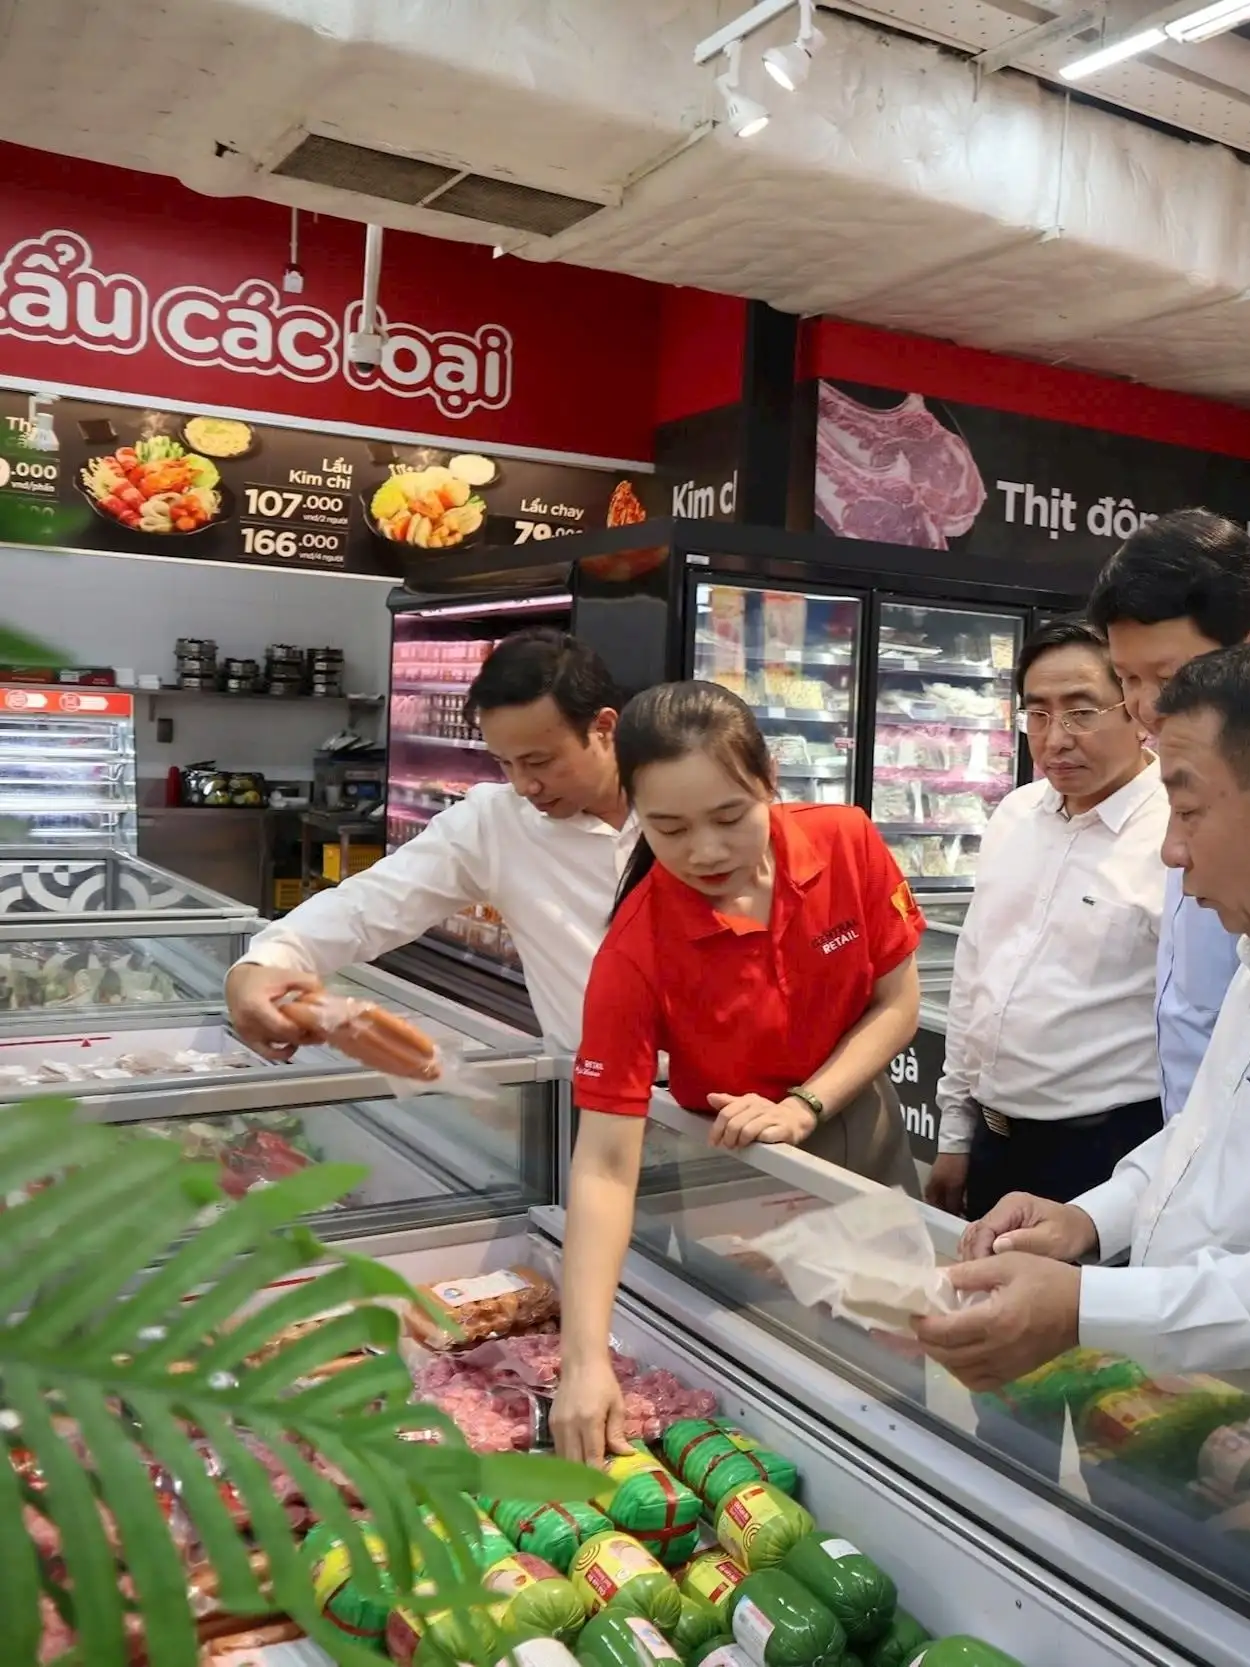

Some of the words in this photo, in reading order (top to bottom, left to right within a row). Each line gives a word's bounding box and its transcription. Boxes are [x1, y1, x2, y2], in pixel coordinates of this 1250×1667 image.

[0, 241, 134, 342] ẩu
[166, 289, 328, 371] các
[288, 469, 322, 487] Kim
[326, 475, 352, 490] chi
[244, 488, 343, 518] 107.000
[550, 503, 585, 520] chay
[672, 480, 715, 520] Kim
[996, 479, 1077, 540] Thịt
[240, 527, 339, 558] 166.000
[822, 929, 860, 955] RETAIL
